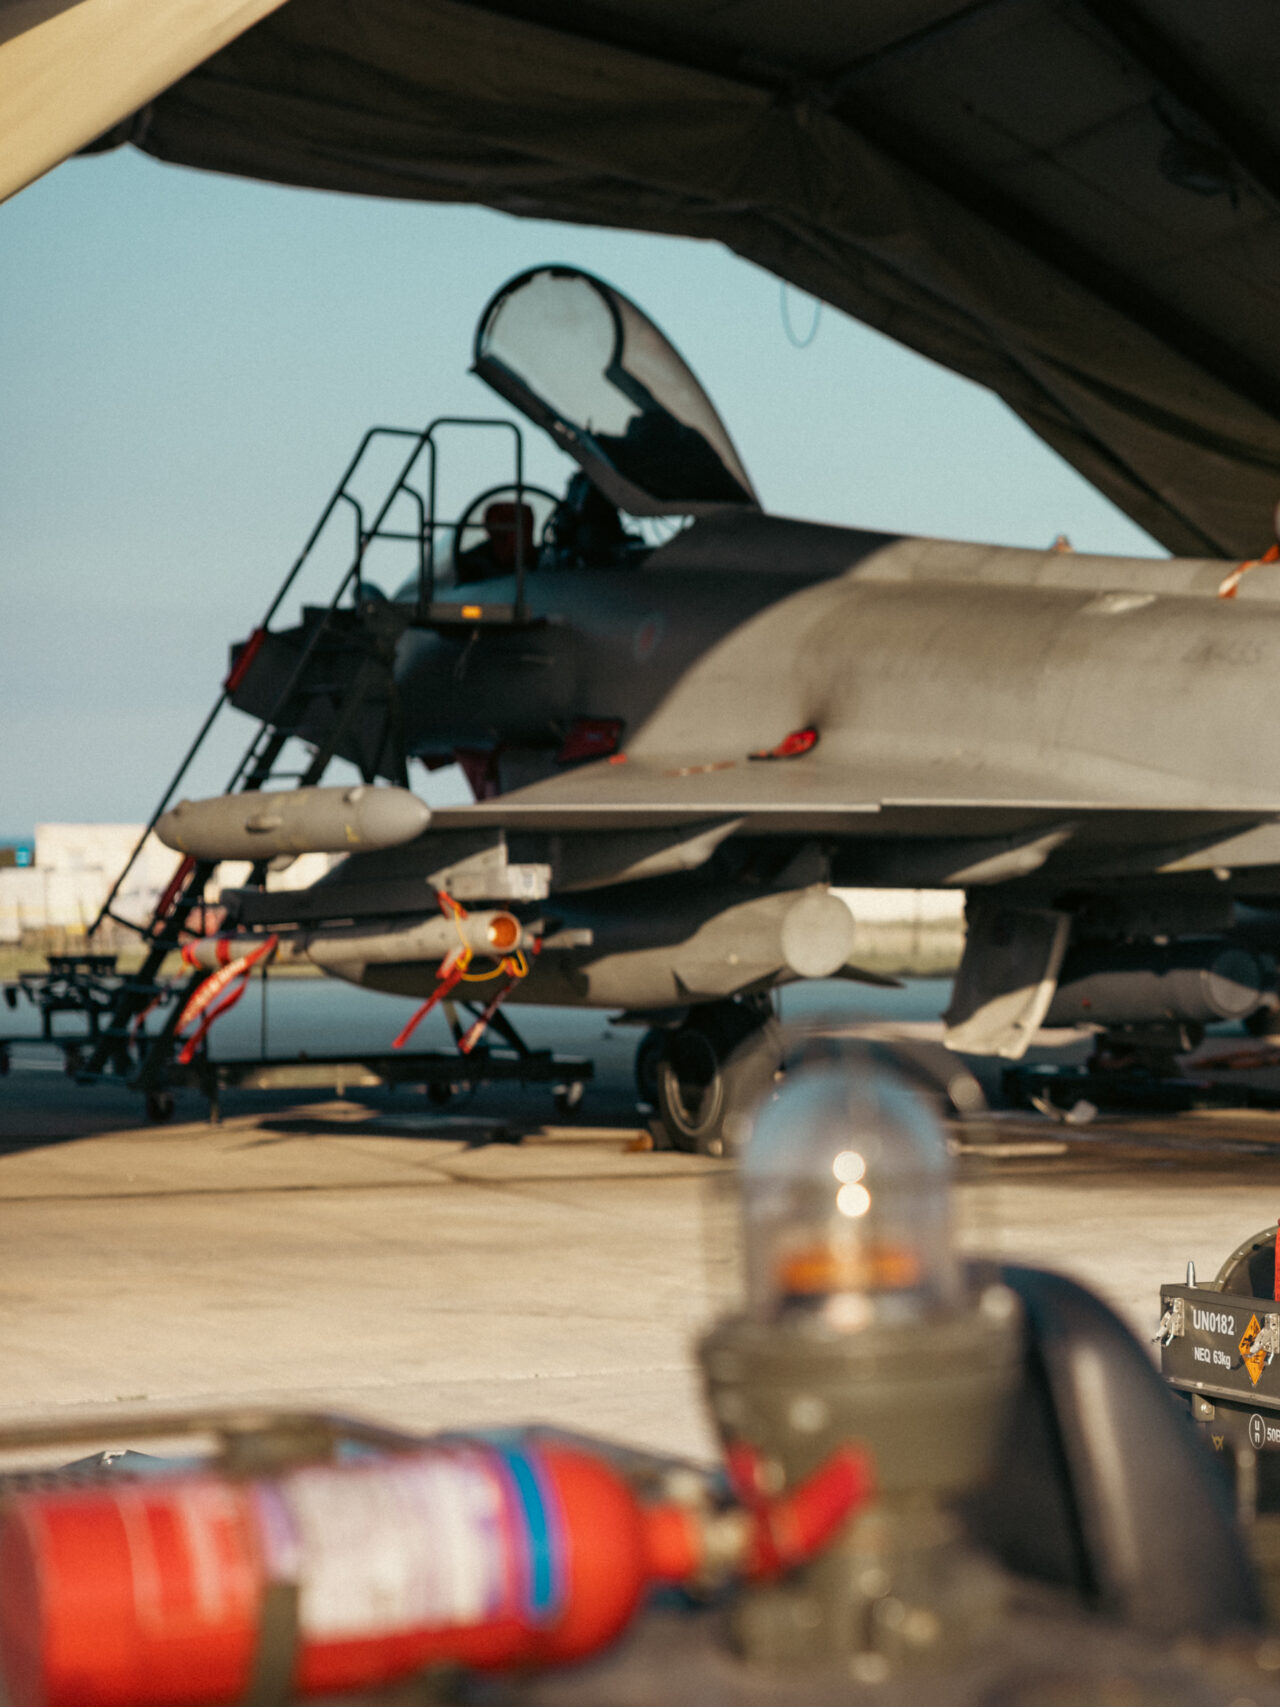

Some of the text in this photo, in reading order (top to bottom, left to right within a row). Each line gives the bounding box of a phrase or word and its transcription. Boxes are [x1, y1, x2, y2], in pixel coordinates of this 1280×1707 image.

[1193, 1309, 1235, 1335] UN0182
[1194, 1347, 1231, 1370] NEQ 63kg
